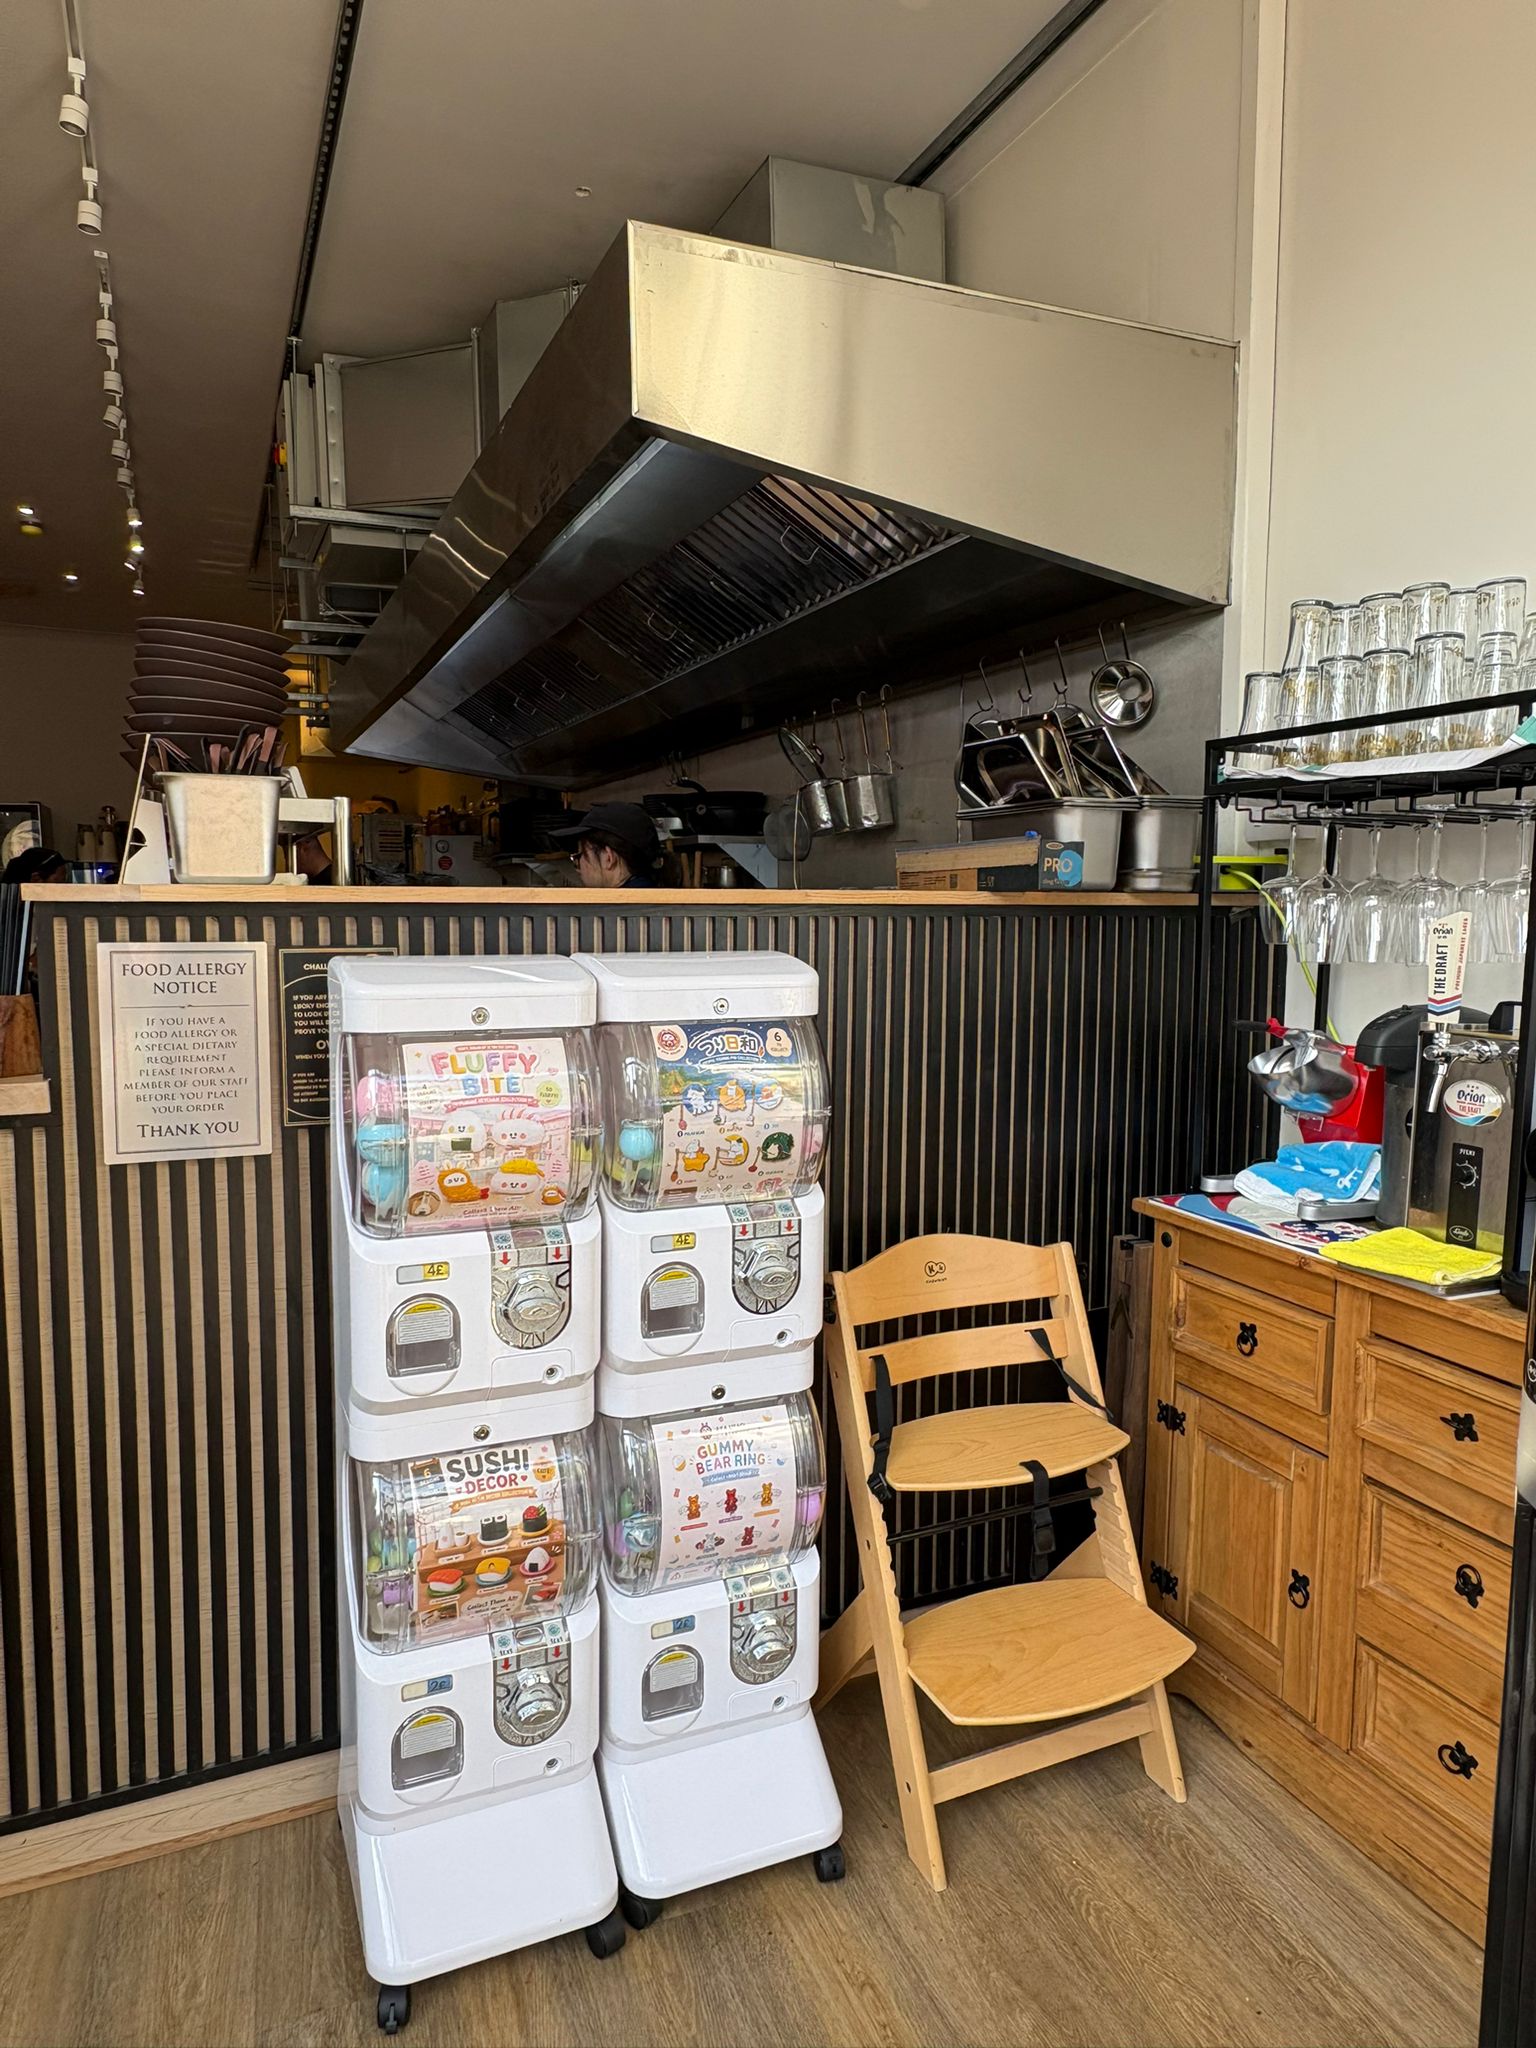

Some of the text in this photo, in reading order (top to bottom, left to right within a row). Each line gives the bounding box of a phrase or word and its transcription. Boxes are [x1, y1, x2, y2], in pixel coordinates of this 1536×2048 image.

[1044, 857, 1072, 873] PRO
[1461, 917, 1469, 935] LAGER
[1458, 937, 1466, 964] JAPANESE
[1435, 943, 1448, 976] DRAFT
[122, 962, 247, 977] FOOD ALLERGY
[153, 981, 217, 994] NOTICE
[1433, 977, 1447, 995] THE
[146, 1017, 156, 1026] IF
[159, 1017, 183, 1026] YOU
[187, 1017, 215, 1025] HAVE
[135, 1029, 238, 1039] FOOD ALLERGY OR
[774, 1031, 782, 1042] 6
[134, 1041, 238, 1052] A SPECIAL DIETARY
[700, 1035, 758, 1056] つり日和
[146, 1054, 227, 1065] REQUIREMENT
[430, 1052, 538, 1076] FLUFFY
[139, 1067, 176, 1077] PLEASE
[180, 1066, 225, 1075] INFORM
[123, 1077, 248, 1090] MEMBER OF OUR STAFF
[462, 1076, 520, 1096] BITE
[136, 1090, 238, 1102] BEFORE YOU PLACE
[1457, 1089, 1486, 1104] Orion
[152, 1103, 224, 1114] YOUR ORDER
[137, 1121, 239, 1138] THANK YOU
[676, 1234, 691, 1245] 4£
[427, 1264, 444, 1276] 4£
[697, 1439, 754, 1460] GUMMY
[446, 1449, 529, 1483] SUSHI
[696, 1453, 766, 1475] BEAR RING
[423, 1468, 432, 1478] 6
[465, 1473, 518, 1494] DECOR
[430, 1680, 447, 1690] 2£
